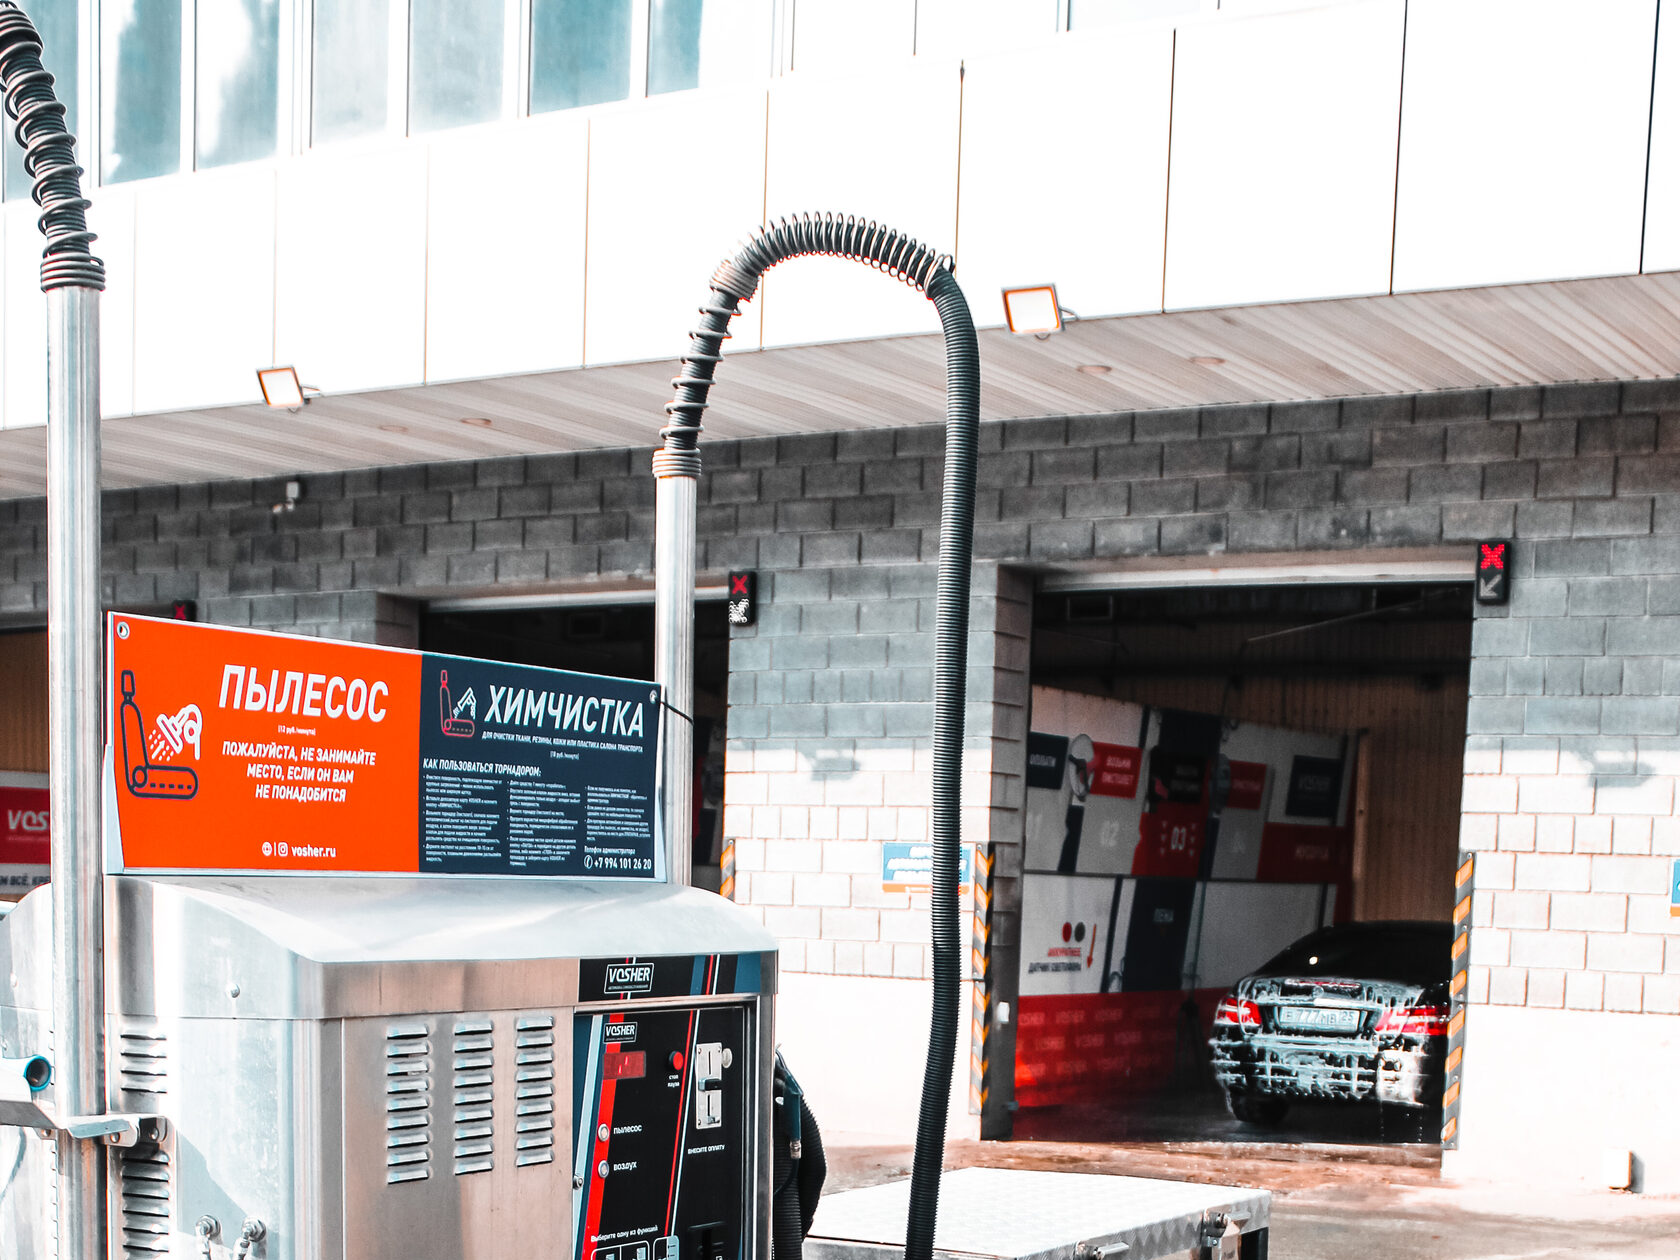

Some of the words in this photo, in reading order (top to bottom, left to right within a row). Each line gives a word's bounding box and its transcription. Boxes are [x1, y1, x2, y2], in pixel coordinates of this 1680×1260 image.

[218, 663, 389, 723] ПЫЛЕСОС
[483, 684, 644, 738] ХИМЧИСТКА
[481, 730, 493, 740] ДЛЯ
[493, 731, 515, 741] ОЧИСТКИ
[515, 733, 532, 744] ТКАНИ,
[532, 735, 553, 745] РЕЗИНЫ,
[577, 740, 600, 749] ПЛАСТИКА
[600, 742, 617, 750] САЛОНА
[617, 743, 643, 753] ТРАНСПОРТА
[222, 740, 298, 762] ПОЖАЛУЙСТА,
[300, 747, 315, 762] НЕ
[316, 748, 377, 766] ЗАНИМАЙТЕ
[246, 763, 285, 781] МЕСТО,
[287, 766, 316, 781] ЕСЛИ
[316, 768, 331, 782] ОН
[332, 769, 354, 784] ВАМ
[423, 757, 439, 770] КАК
[439, 759, 493, 774] ПОЛЬЗОВАТЬСЯ
[495, 763, 541, 777] ТОРНАДОРОМ:
[255, 784, 270, 799] НЕ
[271, 785, 347, 803] ПОНАДОБИТСЯ
[291, 844, 336, 858] vosher.ru
[594, 857, 603, 868] +7
[604, 857, 618, 869] 994
[619, 858, 632, 869] 101
[633, 858, 642, 870] 26
[643, 858, 652, 870] 20
[609, 967, 651, 983] VOSHER
[605, 1024, 635, 1037] VOSHER
[613, 1124, 642, 1135] пылесос
[687, 1146, 708, 1155] ВНЕСИТЕ
[708, 1144, 725, 1152] ОПЛАТУ
[613, 1161, 637, 1171] воздух
[590, 1232, 616, 1243] Выберите
[616, 1230, 629, 1238] одну
